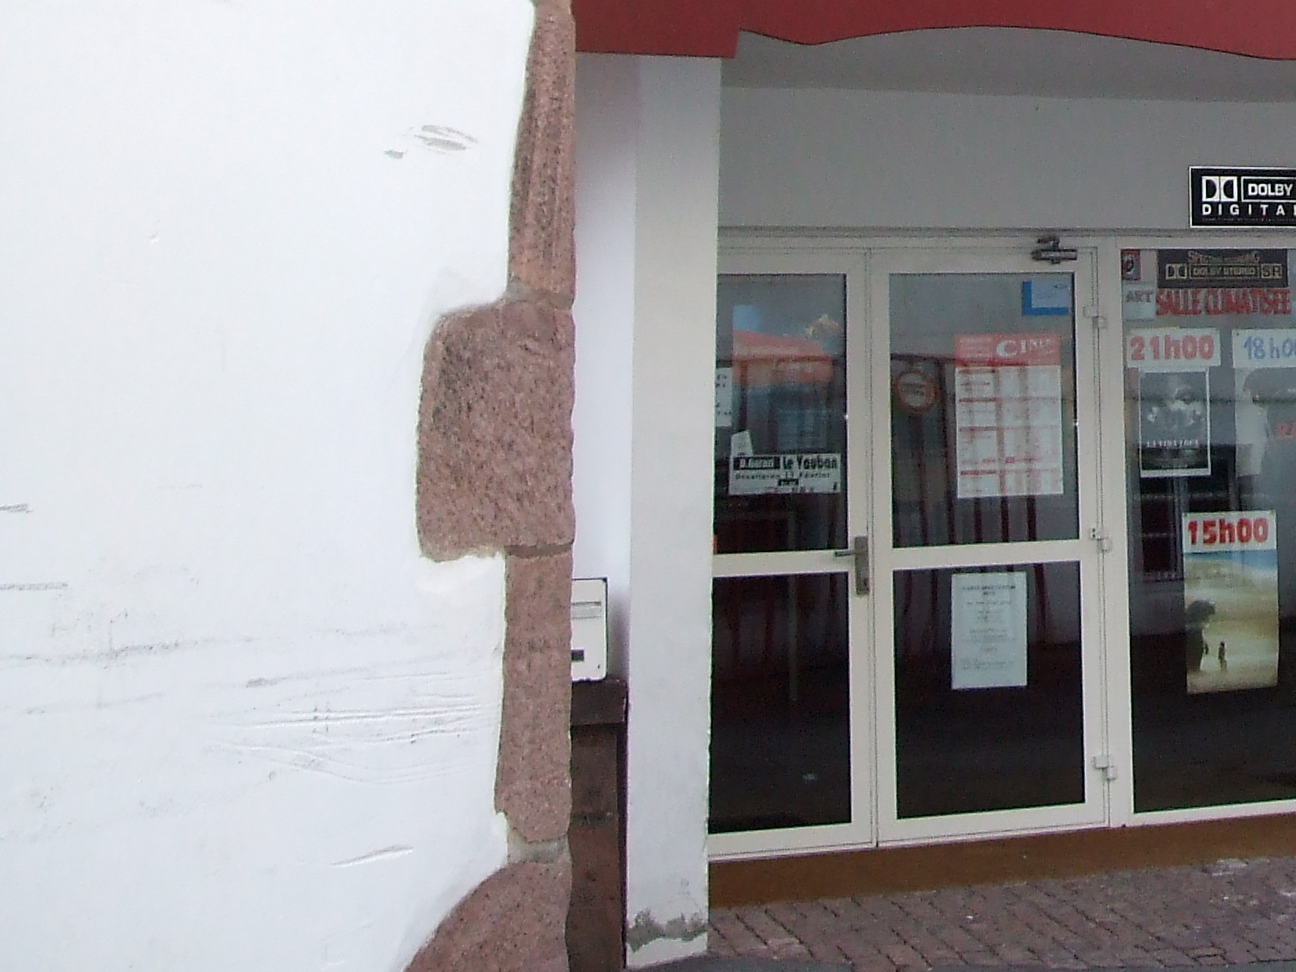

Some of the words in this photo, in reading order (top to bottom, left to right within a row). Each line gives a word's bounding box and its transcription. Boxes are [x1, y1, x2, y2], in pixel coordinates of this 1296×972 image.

[1247, 183, 1293, 197] DOLBY
[1156, 287, 1202, 316] SALLE
[1130, 334, 1215, 361] 21h00
[1187, 516, 1270, 546] 15h00
